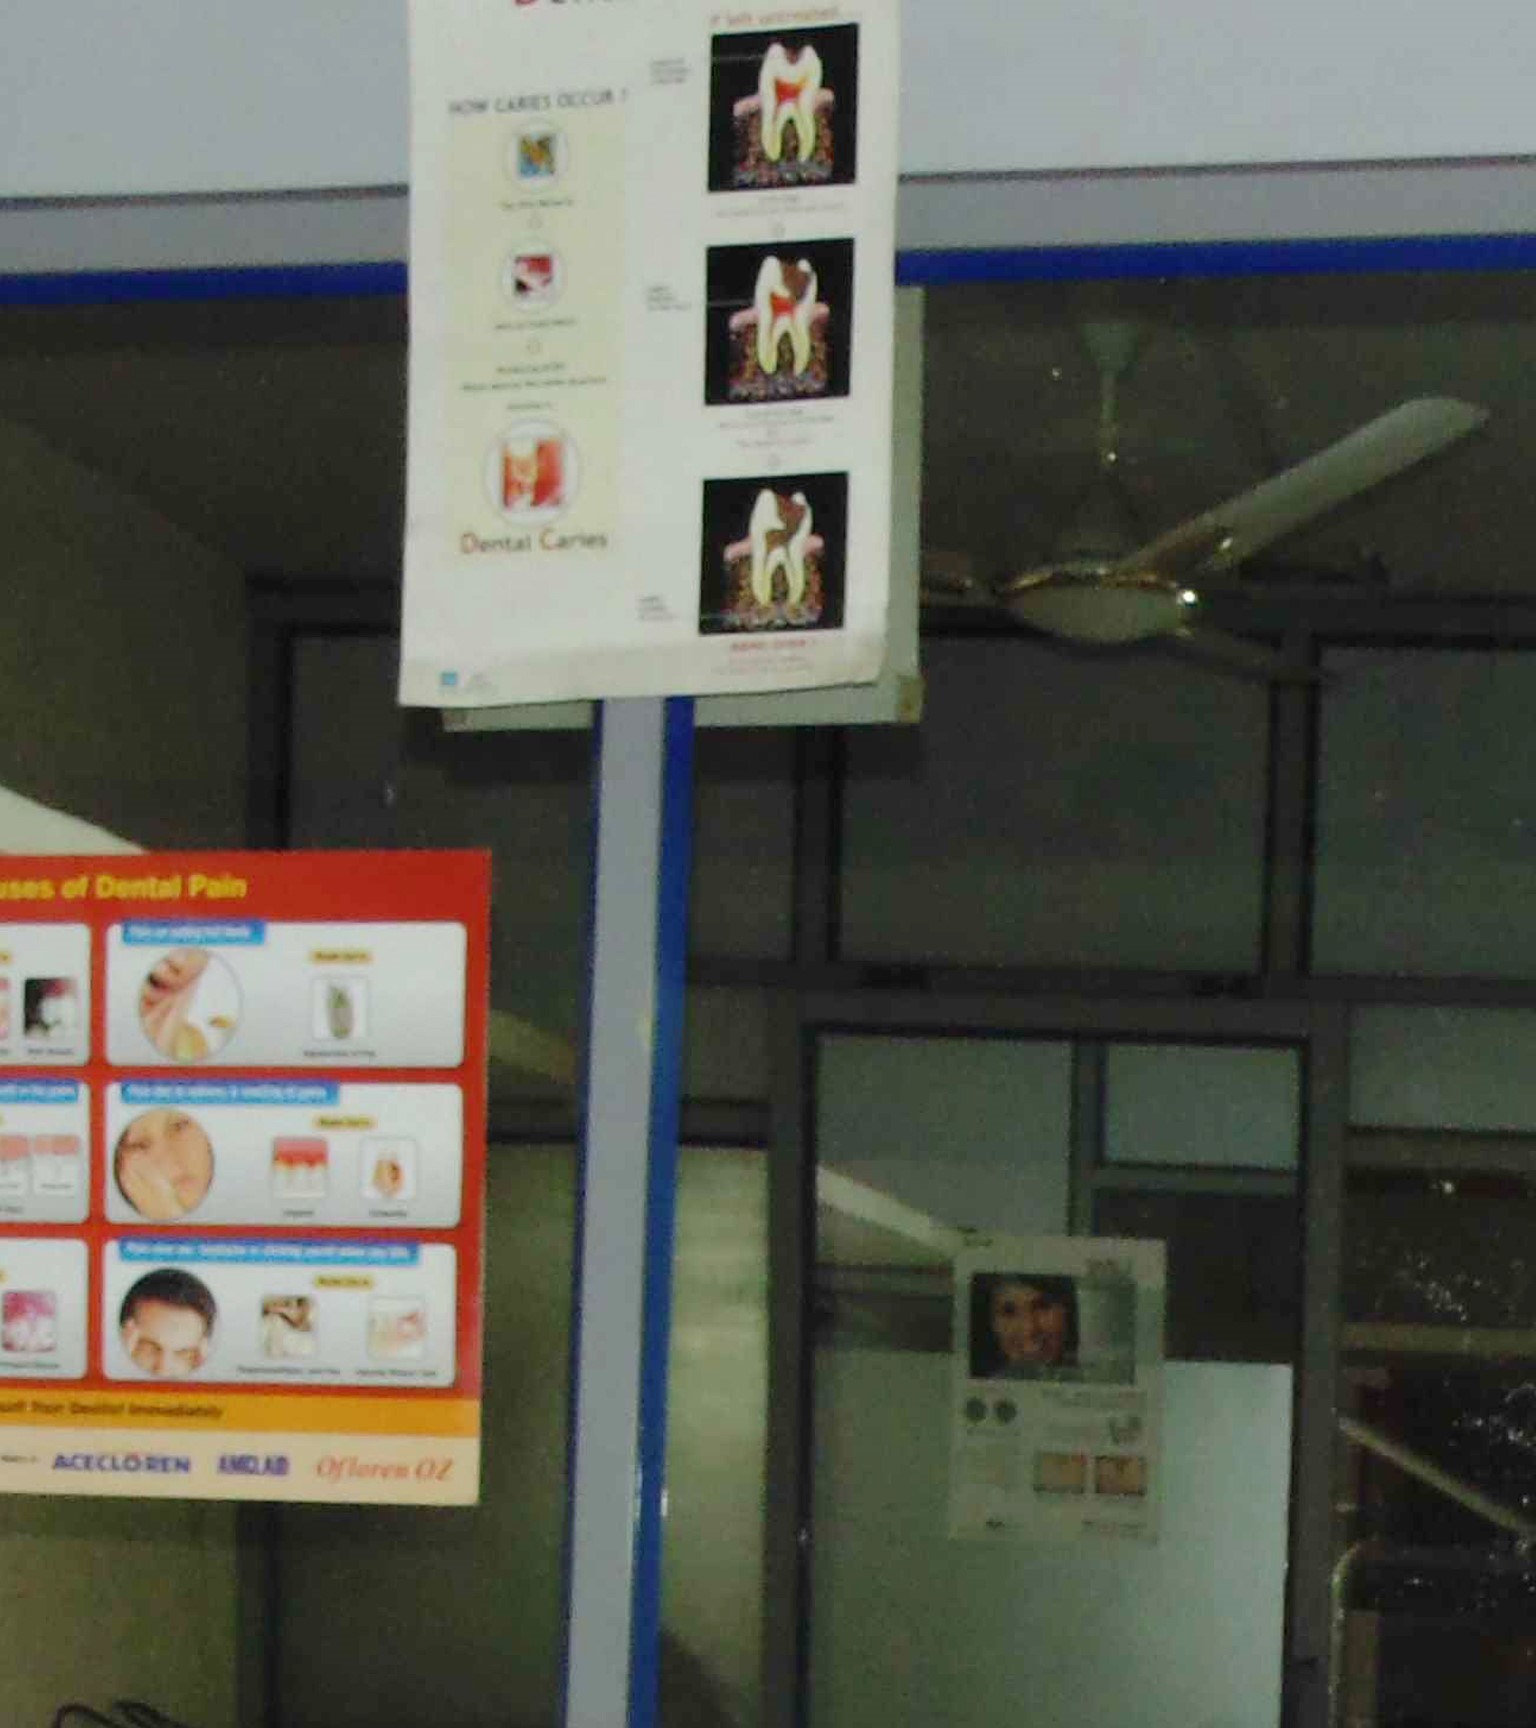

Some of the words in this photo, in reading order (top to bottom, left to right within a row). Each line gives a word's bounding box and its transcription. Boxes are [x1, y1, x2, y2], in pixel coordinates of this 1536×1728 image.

[494, 93, 551, 113] CARIES
[556, 88, 613, 109] OCCUR
[460, 531, 532, 554] Dental
[538, 528, 609, 552] Caries
[61, 874, 90, 898] of
[95, 873, 183, 898] Dental
[188, 873, 248, 898] Pain
